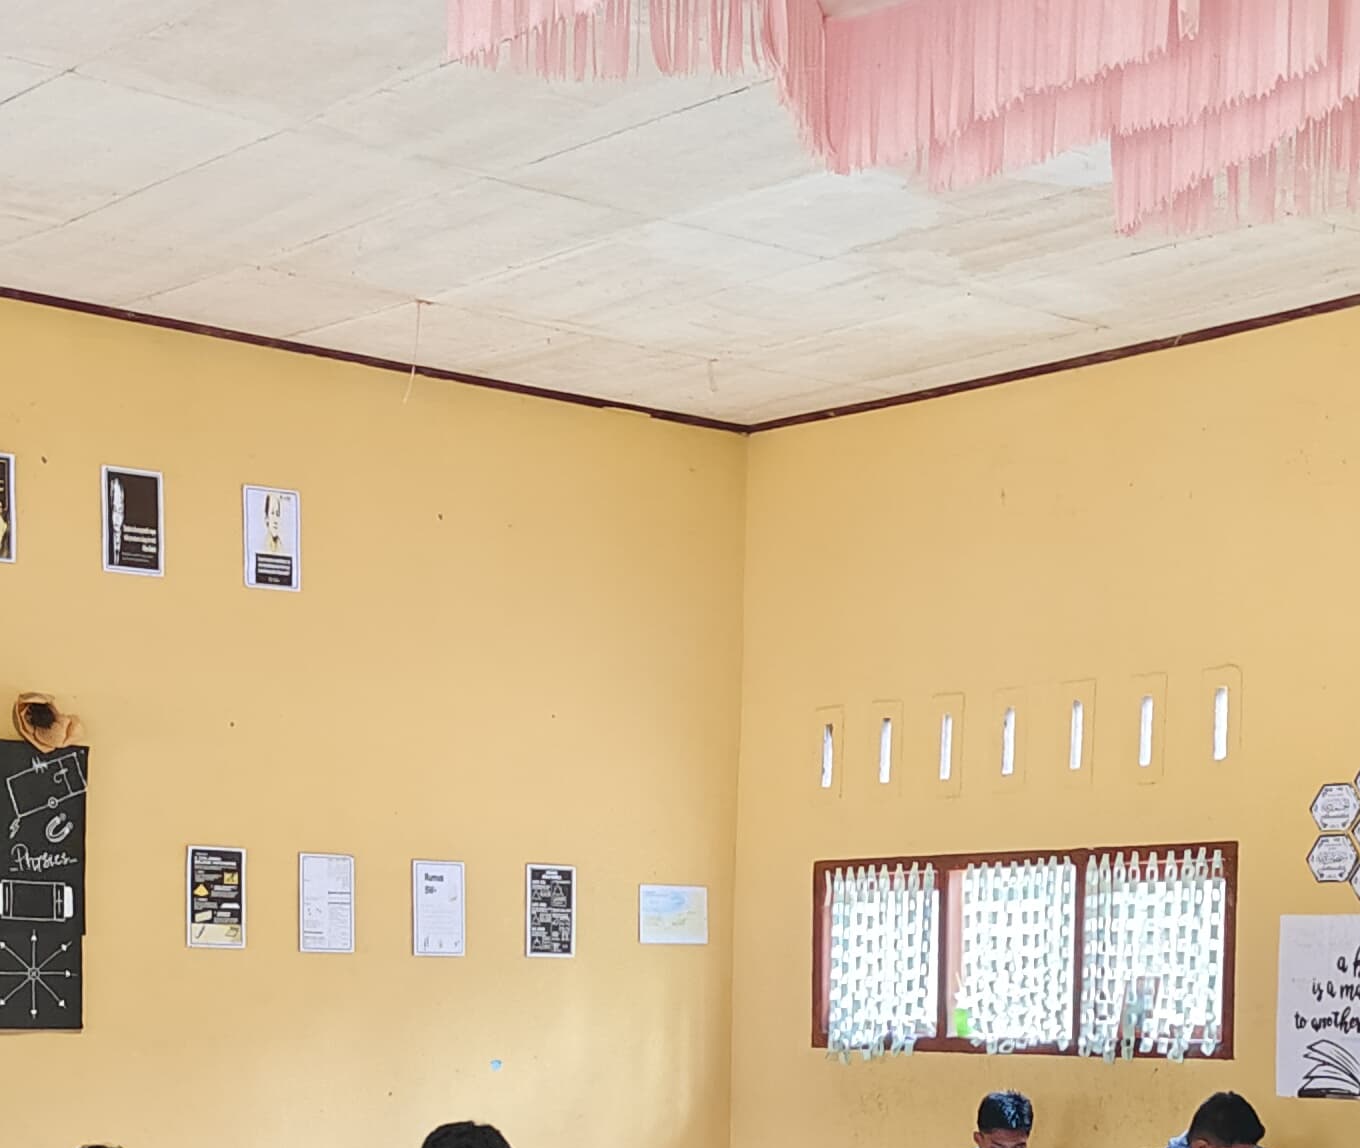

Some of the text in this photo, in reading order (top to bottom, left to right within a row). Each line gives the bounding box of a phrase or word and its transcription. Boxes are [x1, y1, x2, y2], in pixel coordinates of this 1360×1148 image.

[1337, 956, 1348, 973] a
[1312, 978, 1323, 1002] is
[1327, 980, 1336, 998] a
[1294, 1011, 1307, 1029] to
